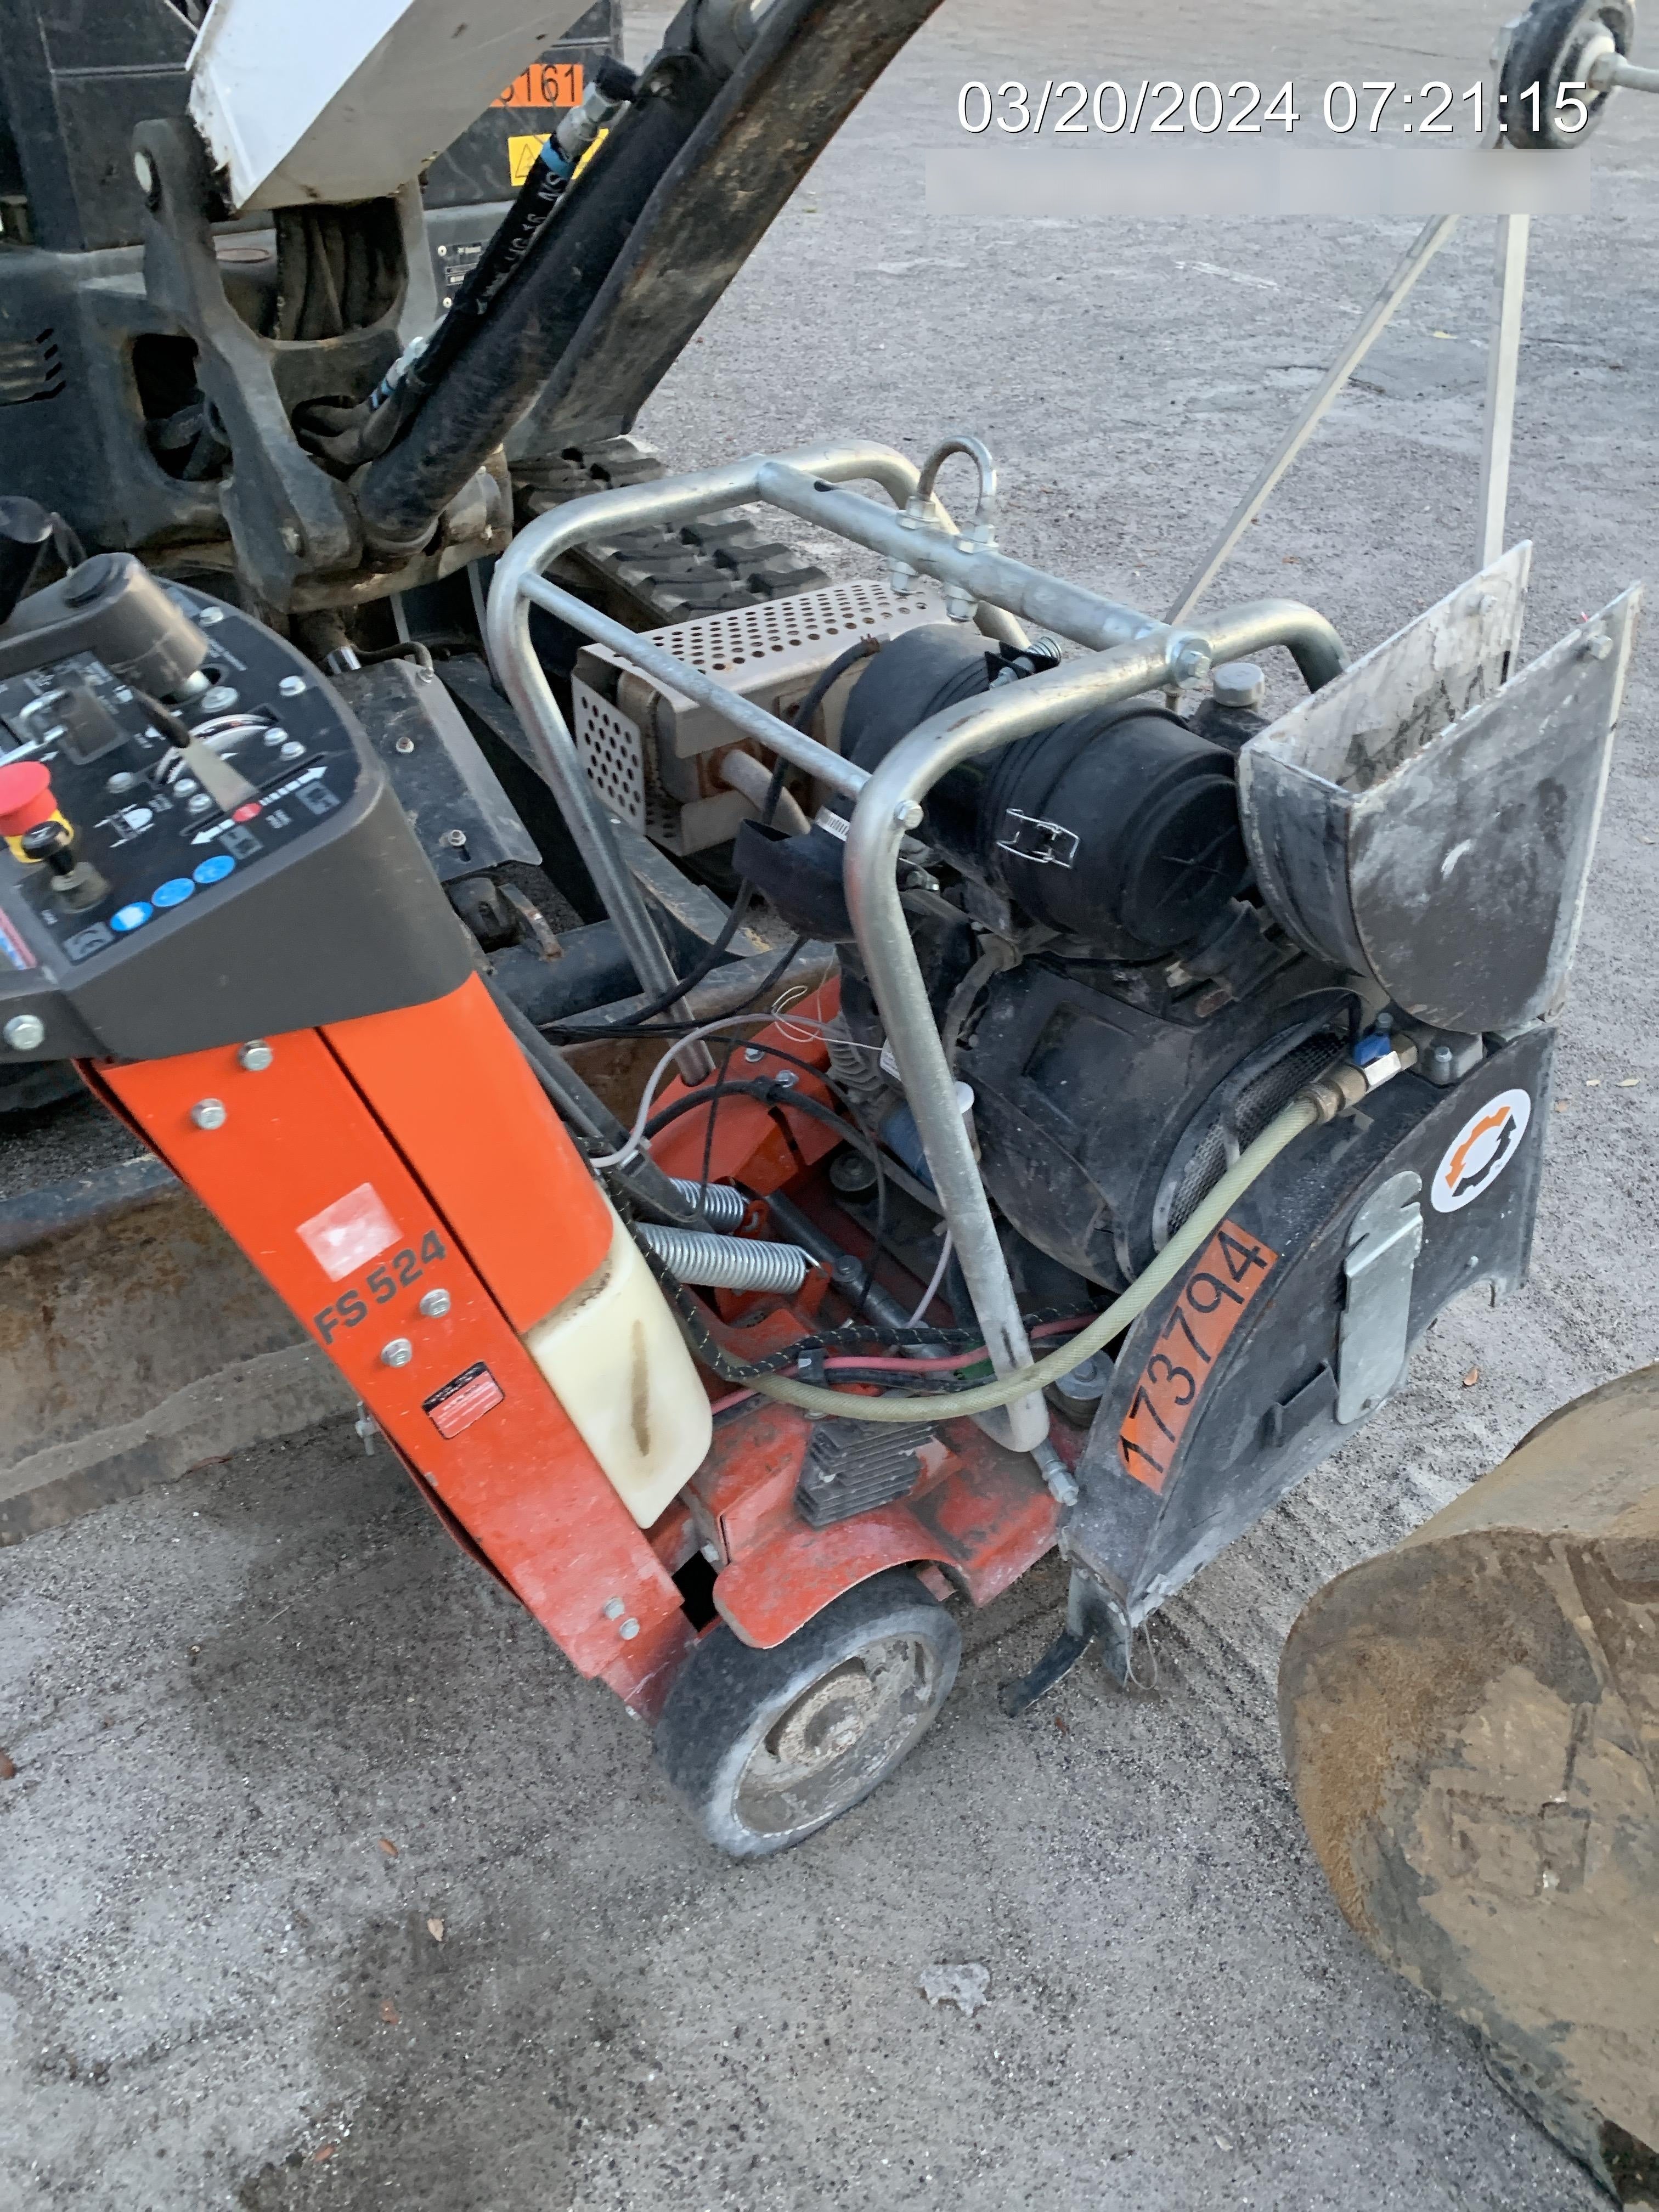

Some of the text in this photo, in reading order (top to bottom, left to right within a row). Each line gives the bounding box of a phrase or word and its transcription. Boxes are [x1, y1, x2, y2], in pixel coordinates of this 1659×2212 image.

[313, 1229, 447, 1345] FS 524
[1119, 1230, 1268, 1474] 173794
